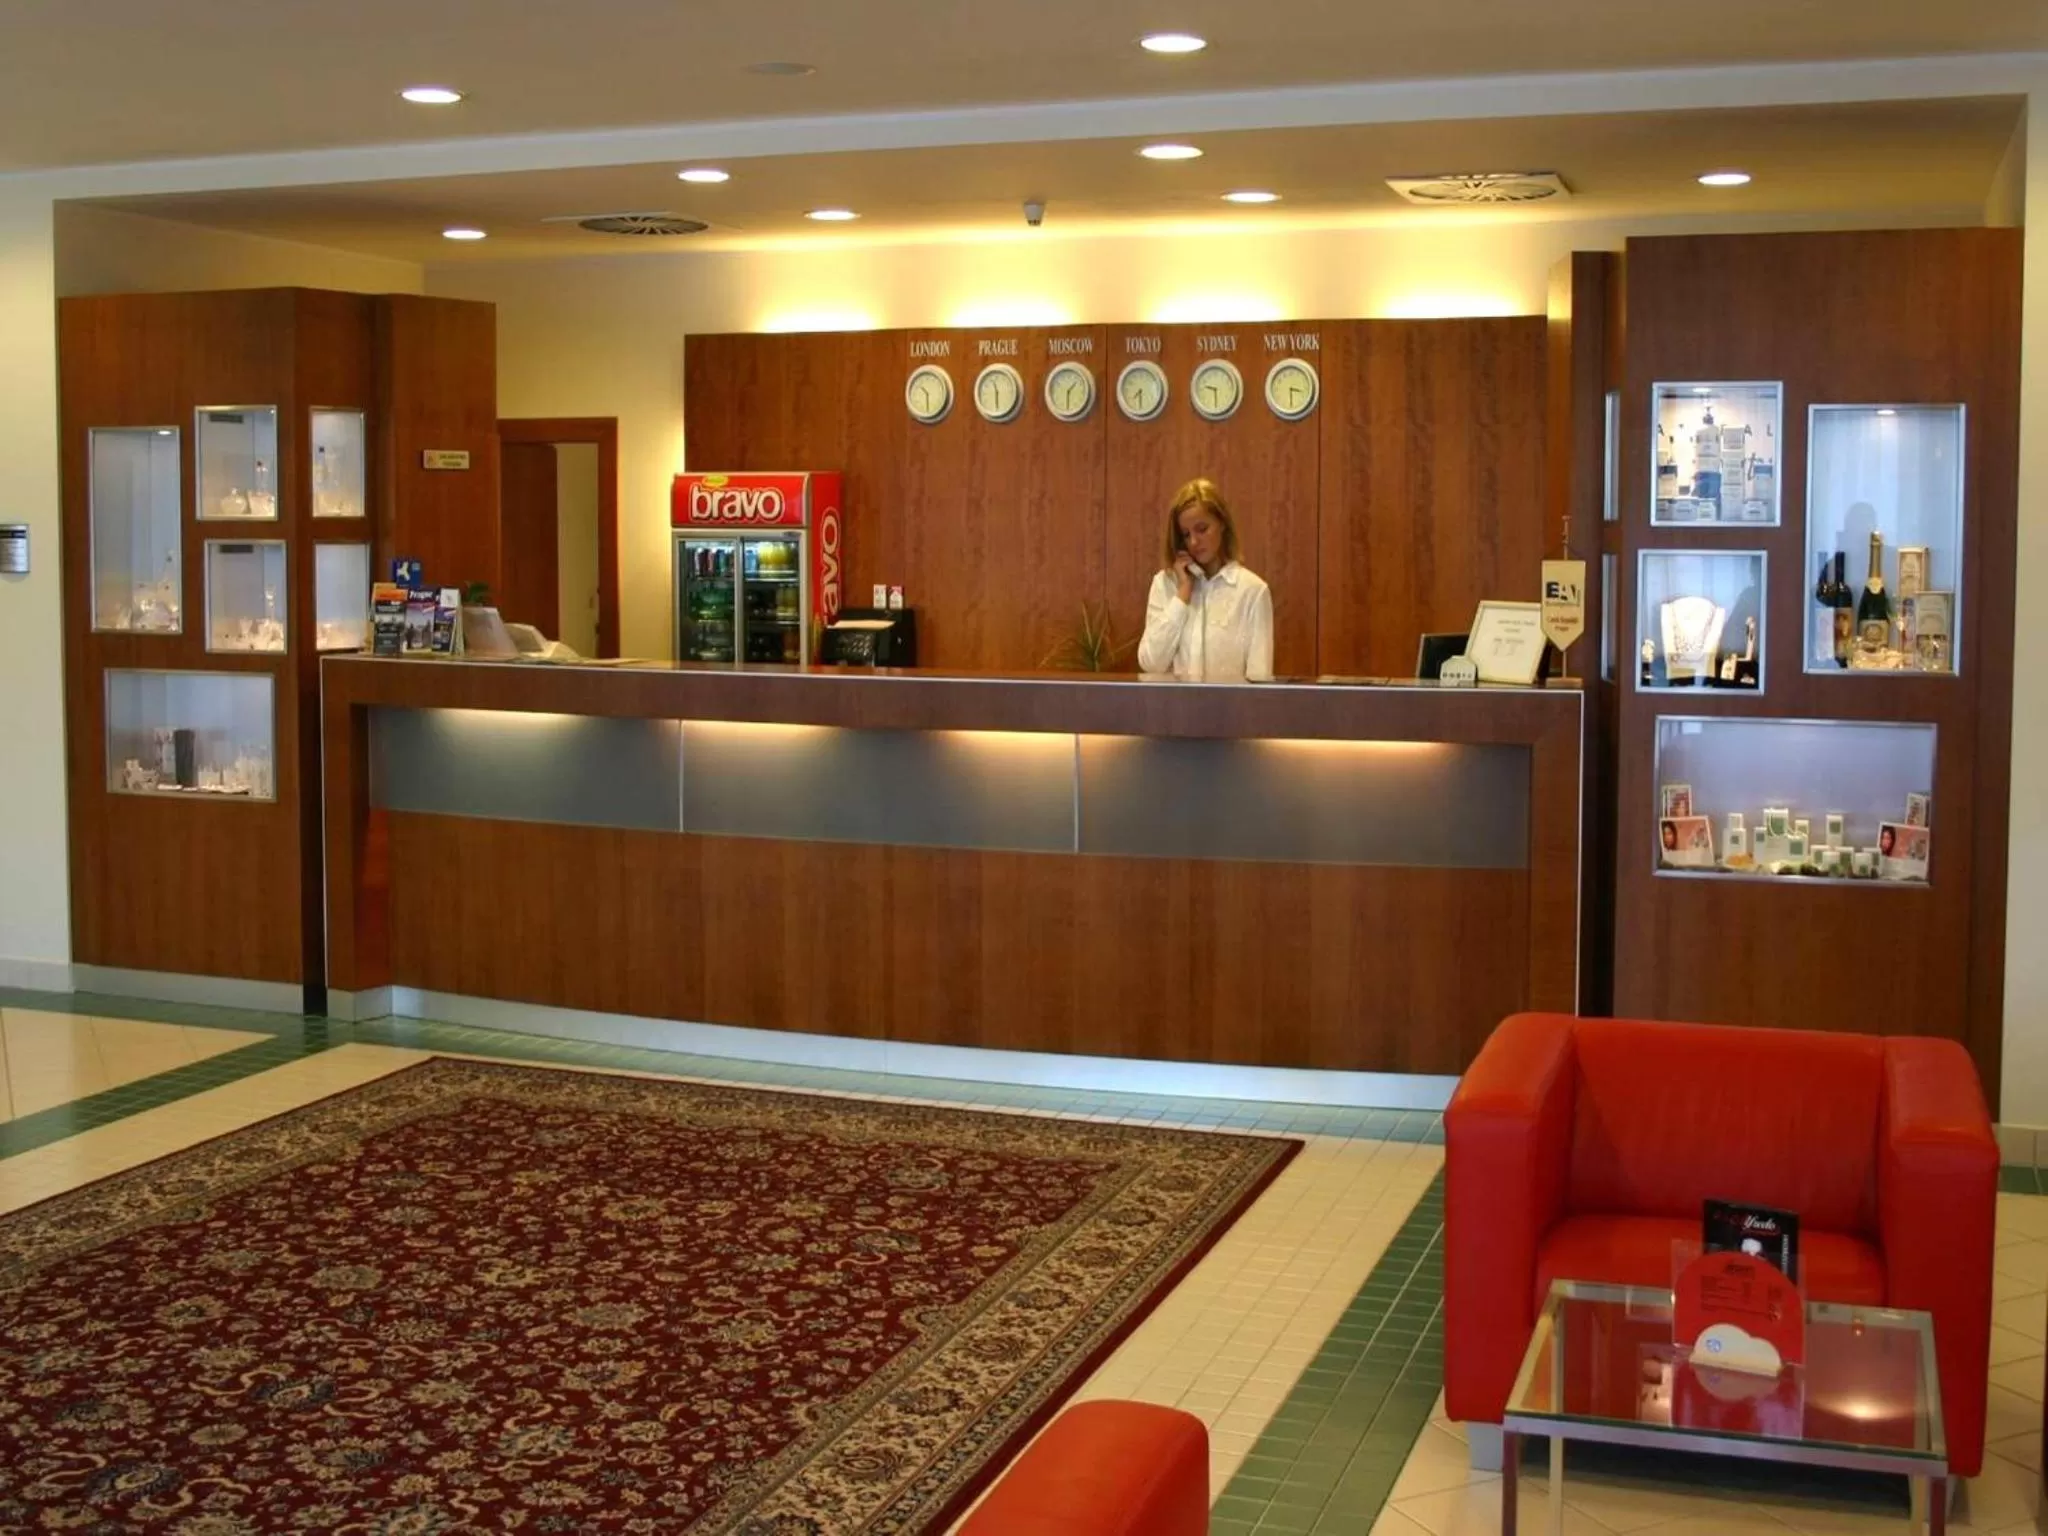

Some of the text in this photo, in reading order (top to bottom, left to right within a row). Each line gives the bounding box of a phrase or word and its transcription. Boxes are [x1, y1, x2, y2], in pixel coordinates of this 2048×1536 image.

[910, 340, 950, 357] LONDON
[978, 339, 1018, 356] PRAGUE
[1049, 337, 1093, 354] MOSCOW
[1125, 336, 1161, 353] TOKYO
[1196, 335, 1238, 352] SYDNEY
[1263, 332, 1320, 351] NEW YORK
[690, 484, 782, 520] bravo
